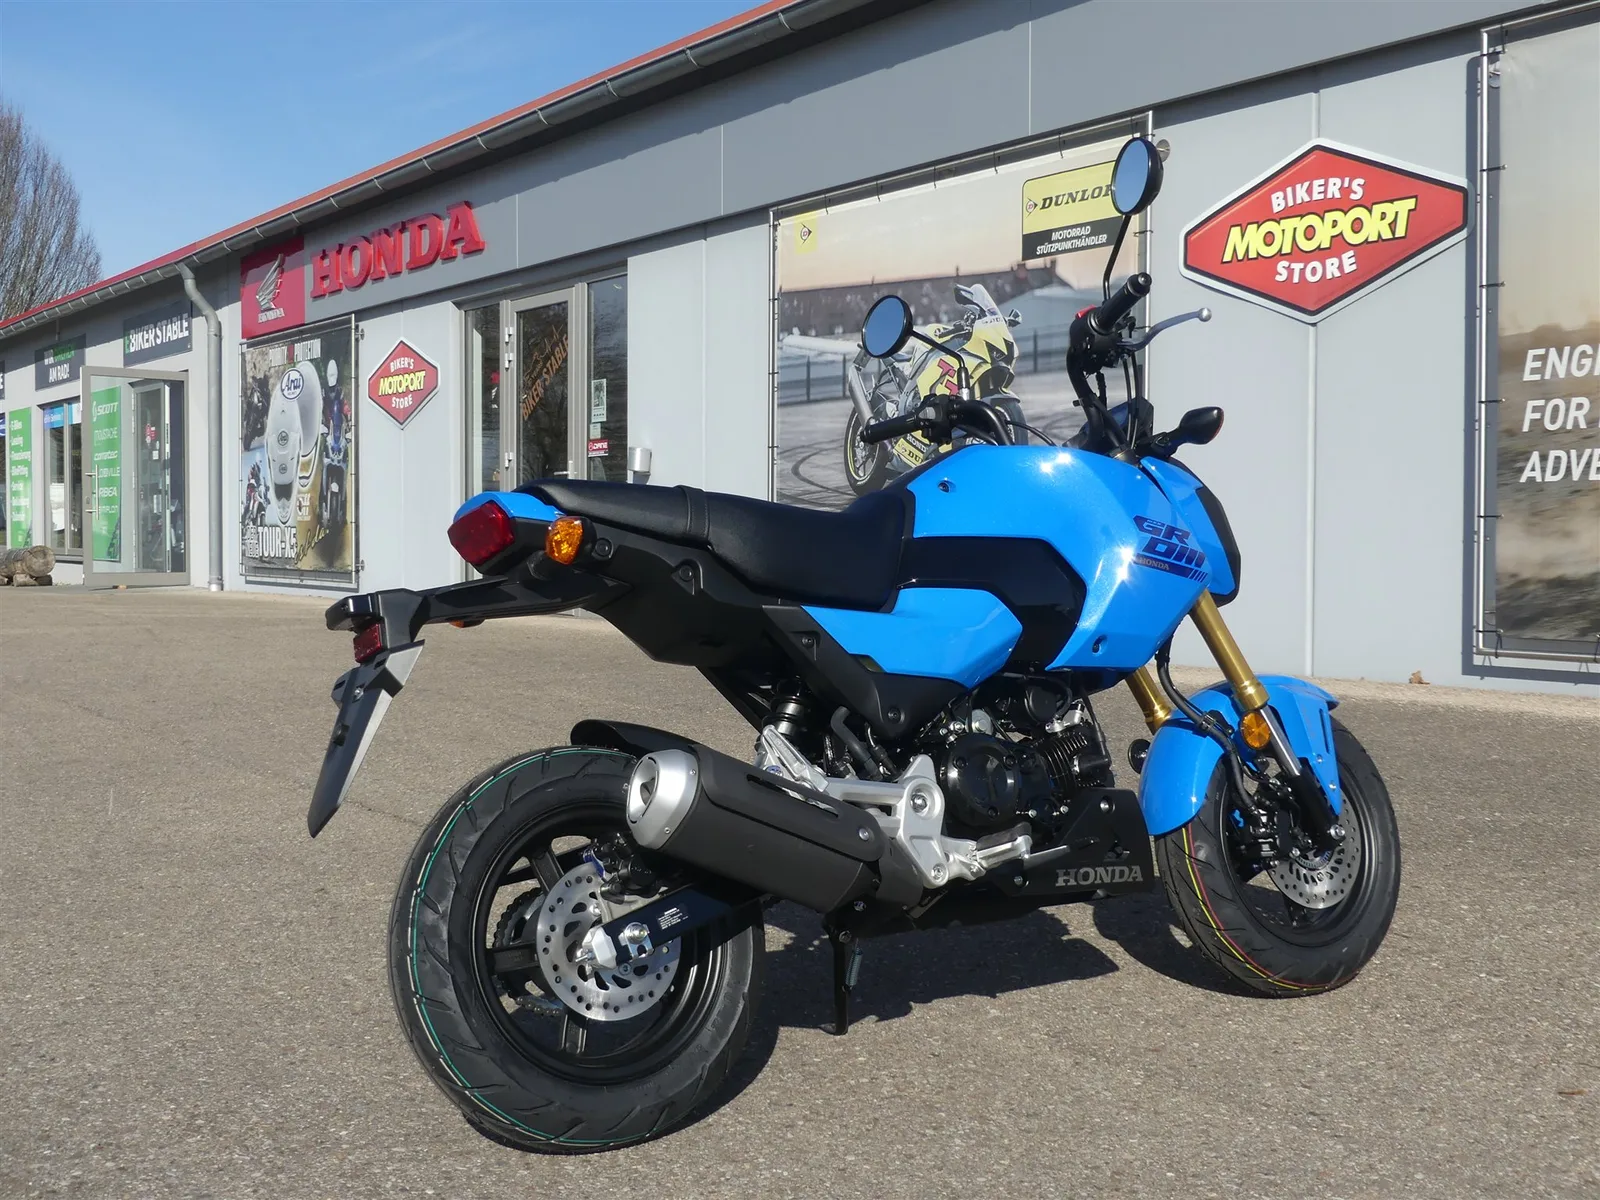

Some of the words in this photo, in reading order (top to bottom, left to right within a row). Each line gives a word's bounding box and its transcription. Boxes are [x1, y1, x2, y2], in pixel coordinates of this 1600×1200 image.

[1271, 177, 1365, 214] BIKER'S
[1051, 226, 1091, 241] MOTORRAD
[1221, 195, 1418, 264] MOTOPORT
[310, 200, 486, 299] HONDA
[1036, 234, 1108, 255] STÜTZPUNKTHÄNDLER
[1275, 250, 1358, 284] STORE
[156, 313, 189, 345] STABLE
[390, 357, 414, 373] BIKER'S
[379, 370, 426, 396] MOTOPORT
[97, 402, 119, 416] SCOTT
[391, 394, 413, 408] STORE
[520, 379, 545, 421] BIKER
[1522, 397, 1590, 432] FOR
[906, 433, 927, 453] HOND
[257, 525, 297, 558] TOUR-X5
[1055, 865, 1143, 886] HONDA
